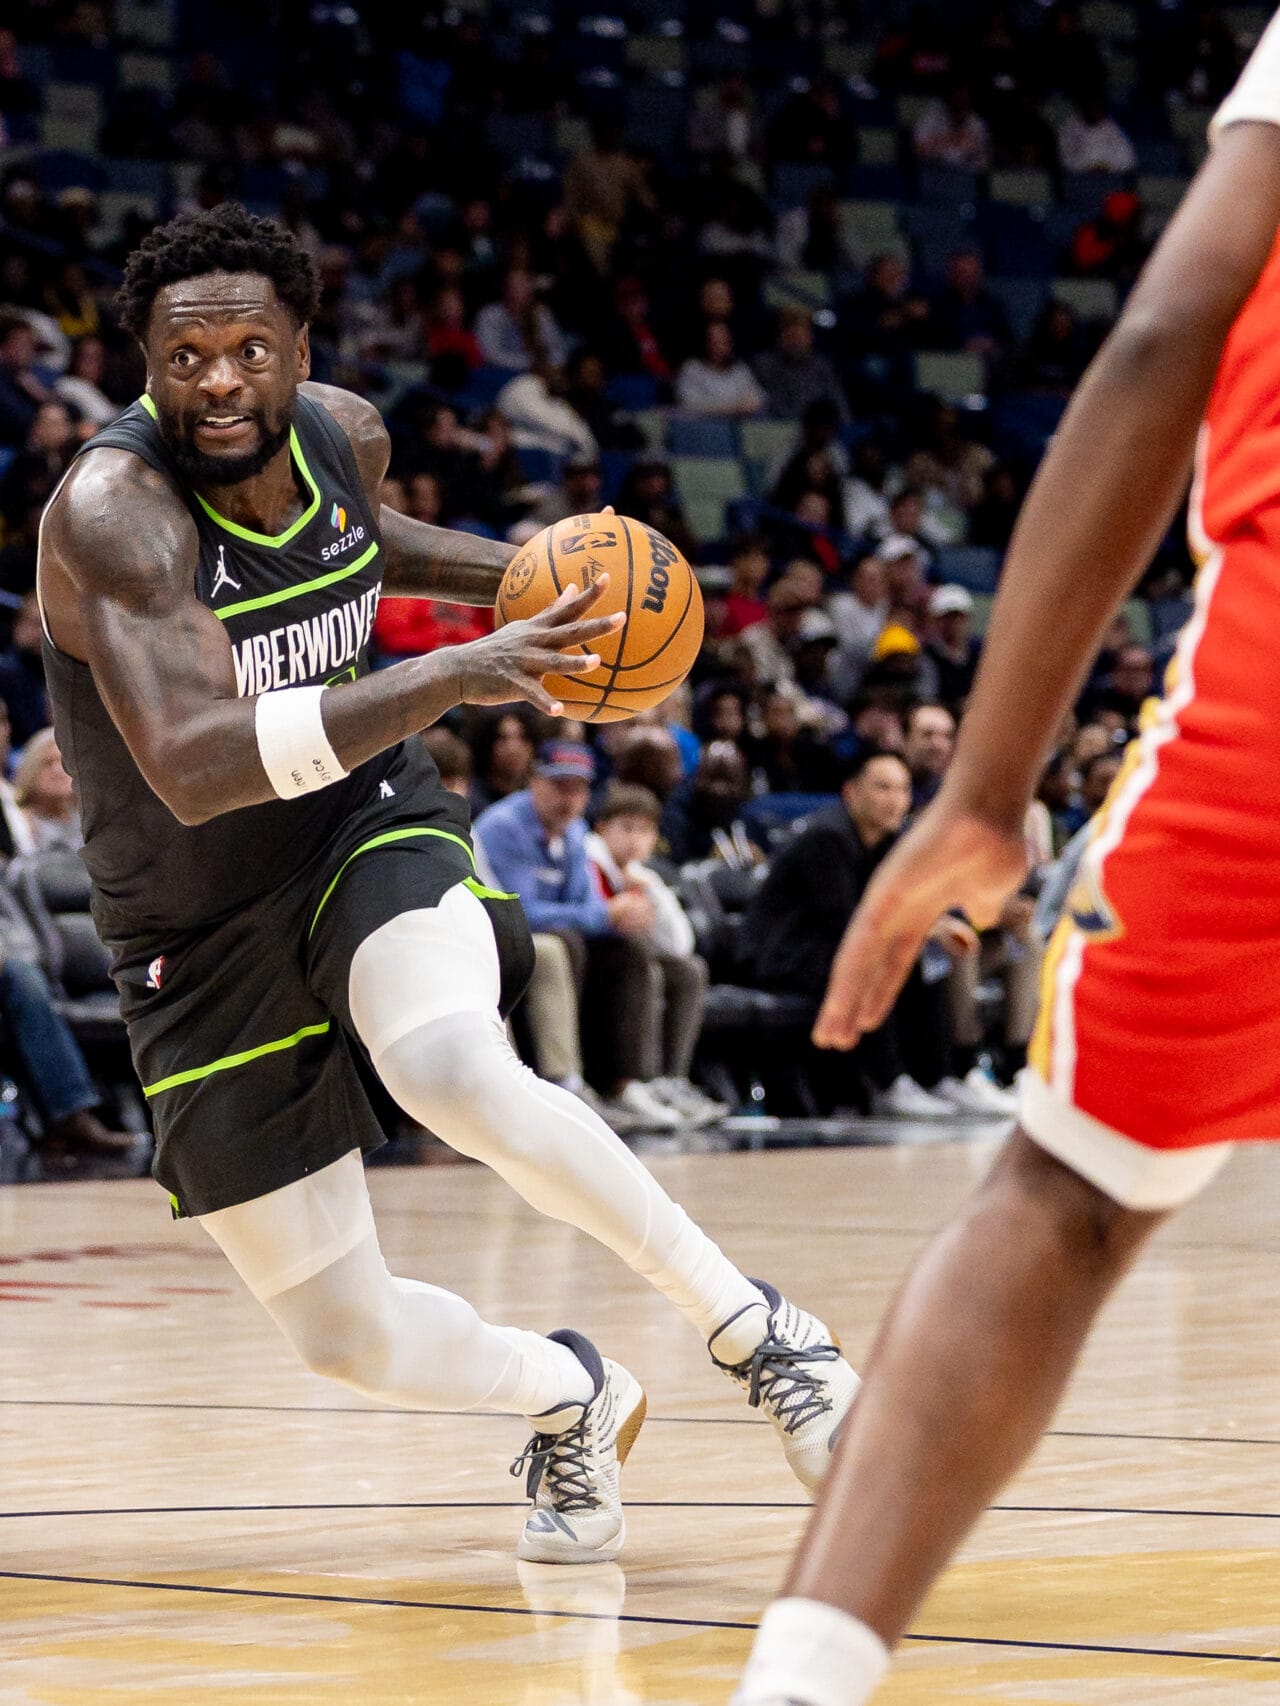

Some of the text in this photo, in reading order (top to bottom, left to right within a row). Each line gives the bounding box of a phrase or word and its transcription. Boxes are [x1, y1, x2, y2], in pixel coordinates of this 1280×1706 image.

[321, 525, 365, 561] sezzle
[639, 521, 679, 614] ilson
[231, 581, 382, 699] MBERWOLVE
